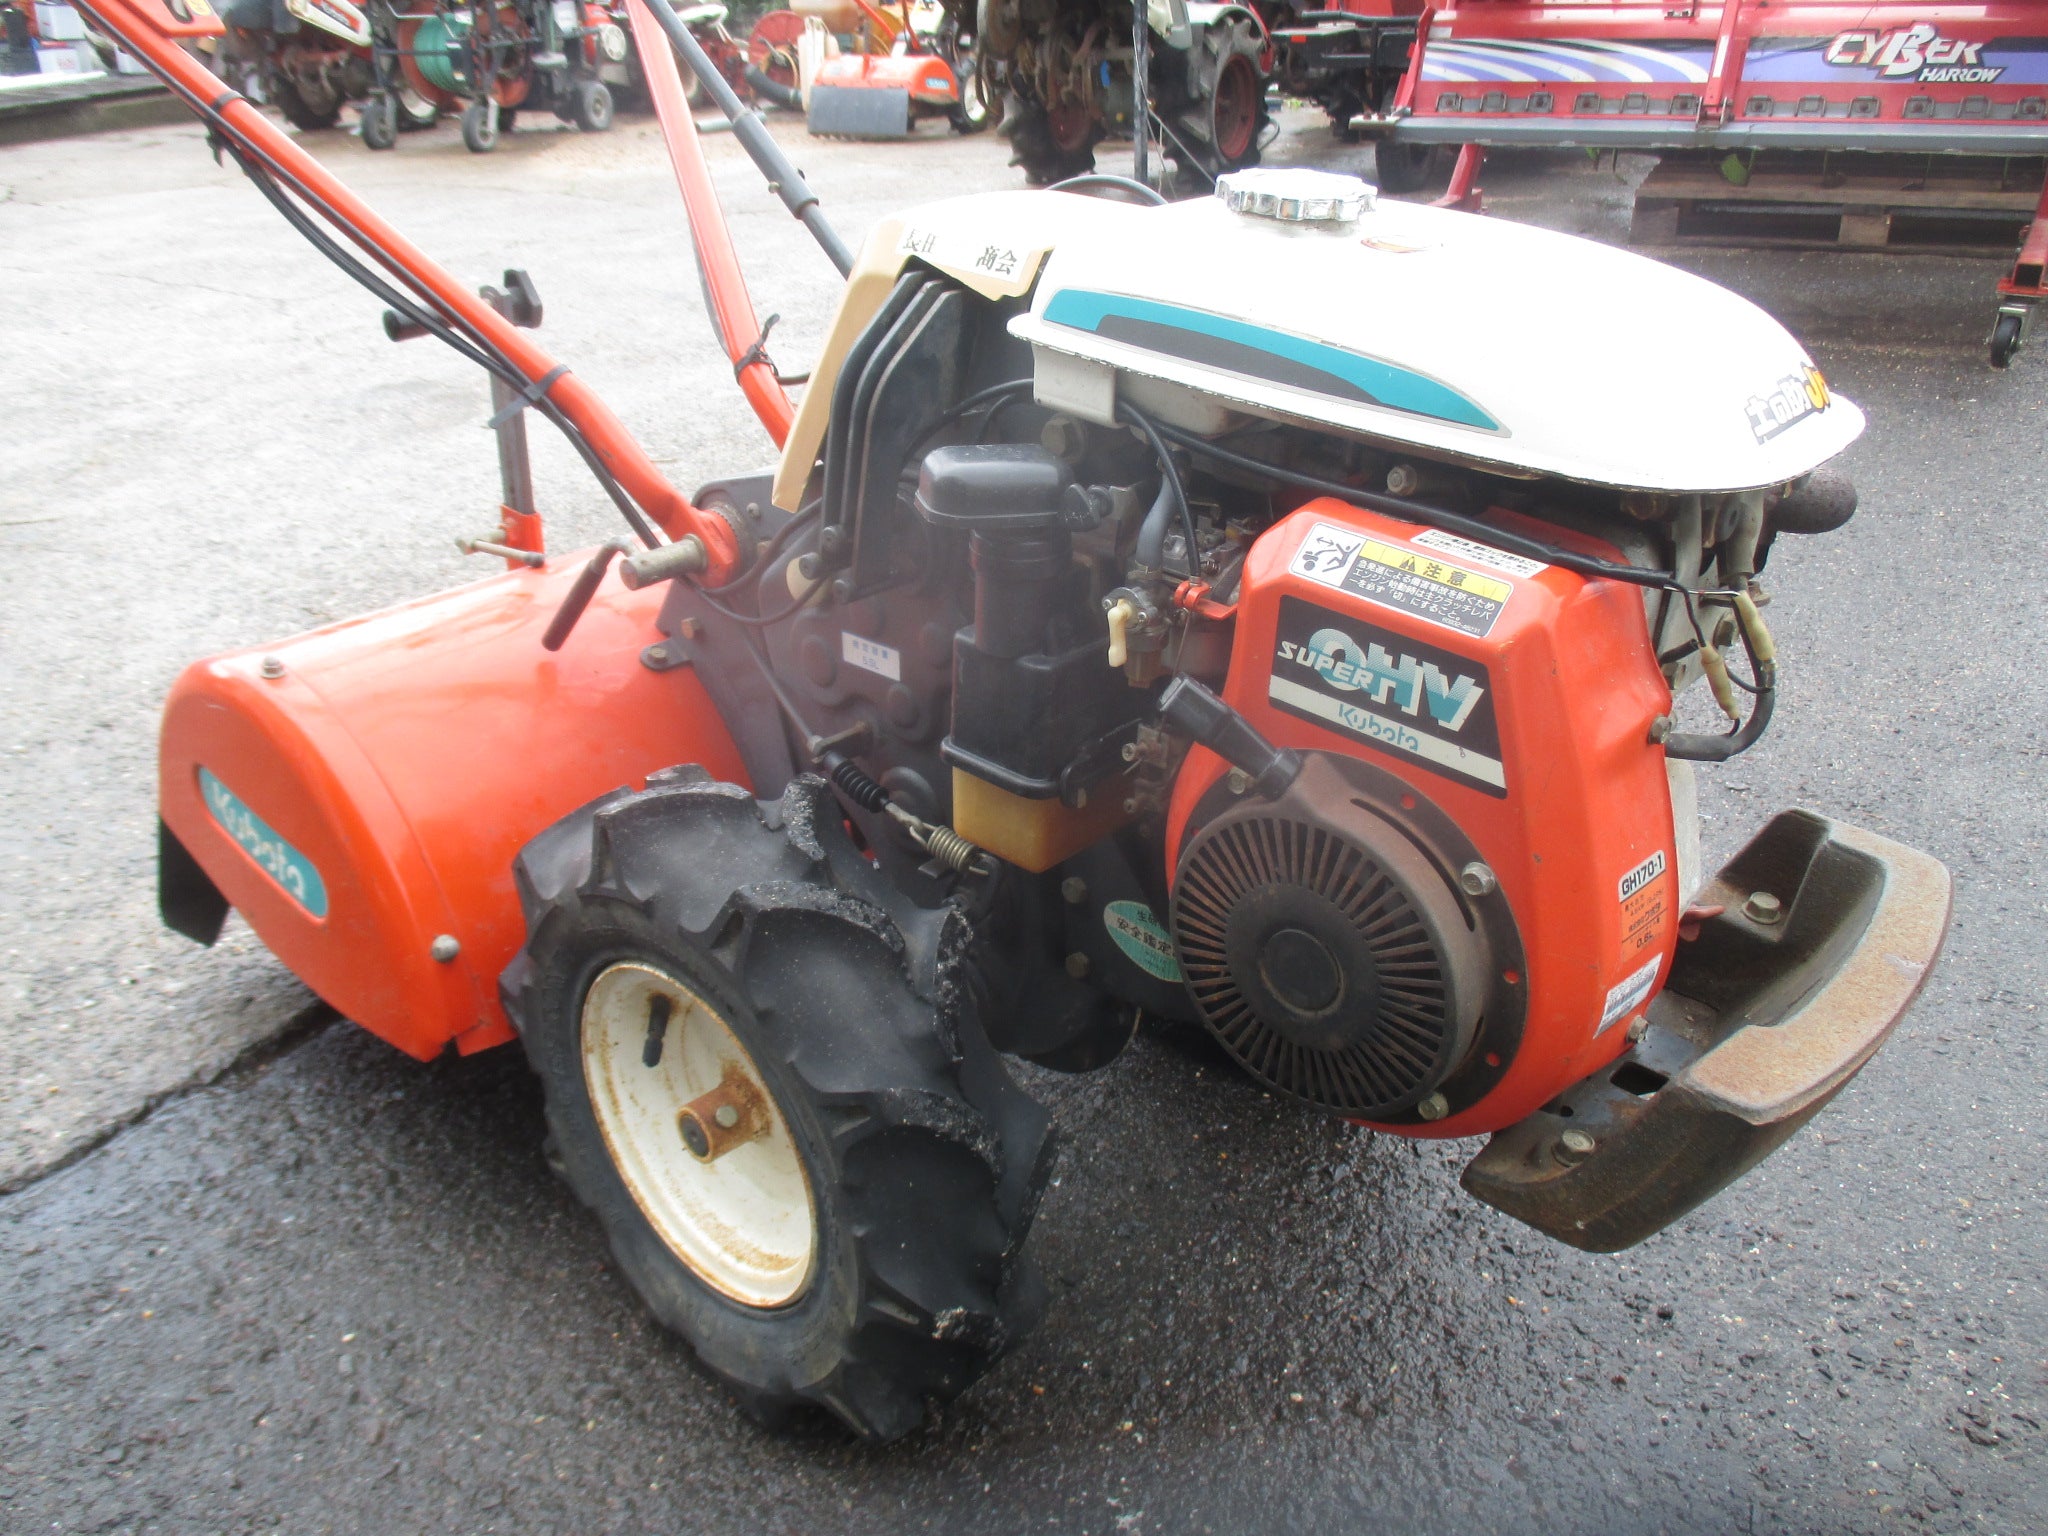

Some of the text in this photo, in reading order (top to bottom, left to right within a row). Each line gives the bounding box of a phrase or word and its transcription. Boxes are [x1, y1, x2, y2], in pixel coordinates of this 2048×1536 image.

[1825, 22, 1984, 77] CYBER
[1918, 67, 2001, 83] HARROW
[976, 245, 1017, 275] 商会
[1423, 562, 1467, 587] 注意
[1277, 640, 1373, 690] SUPER
[1308, 628, 1484, 733] OHV
[1338, 703, 1420, 752] Kubota
[1621, 853, 1663, 896] GH170-1
